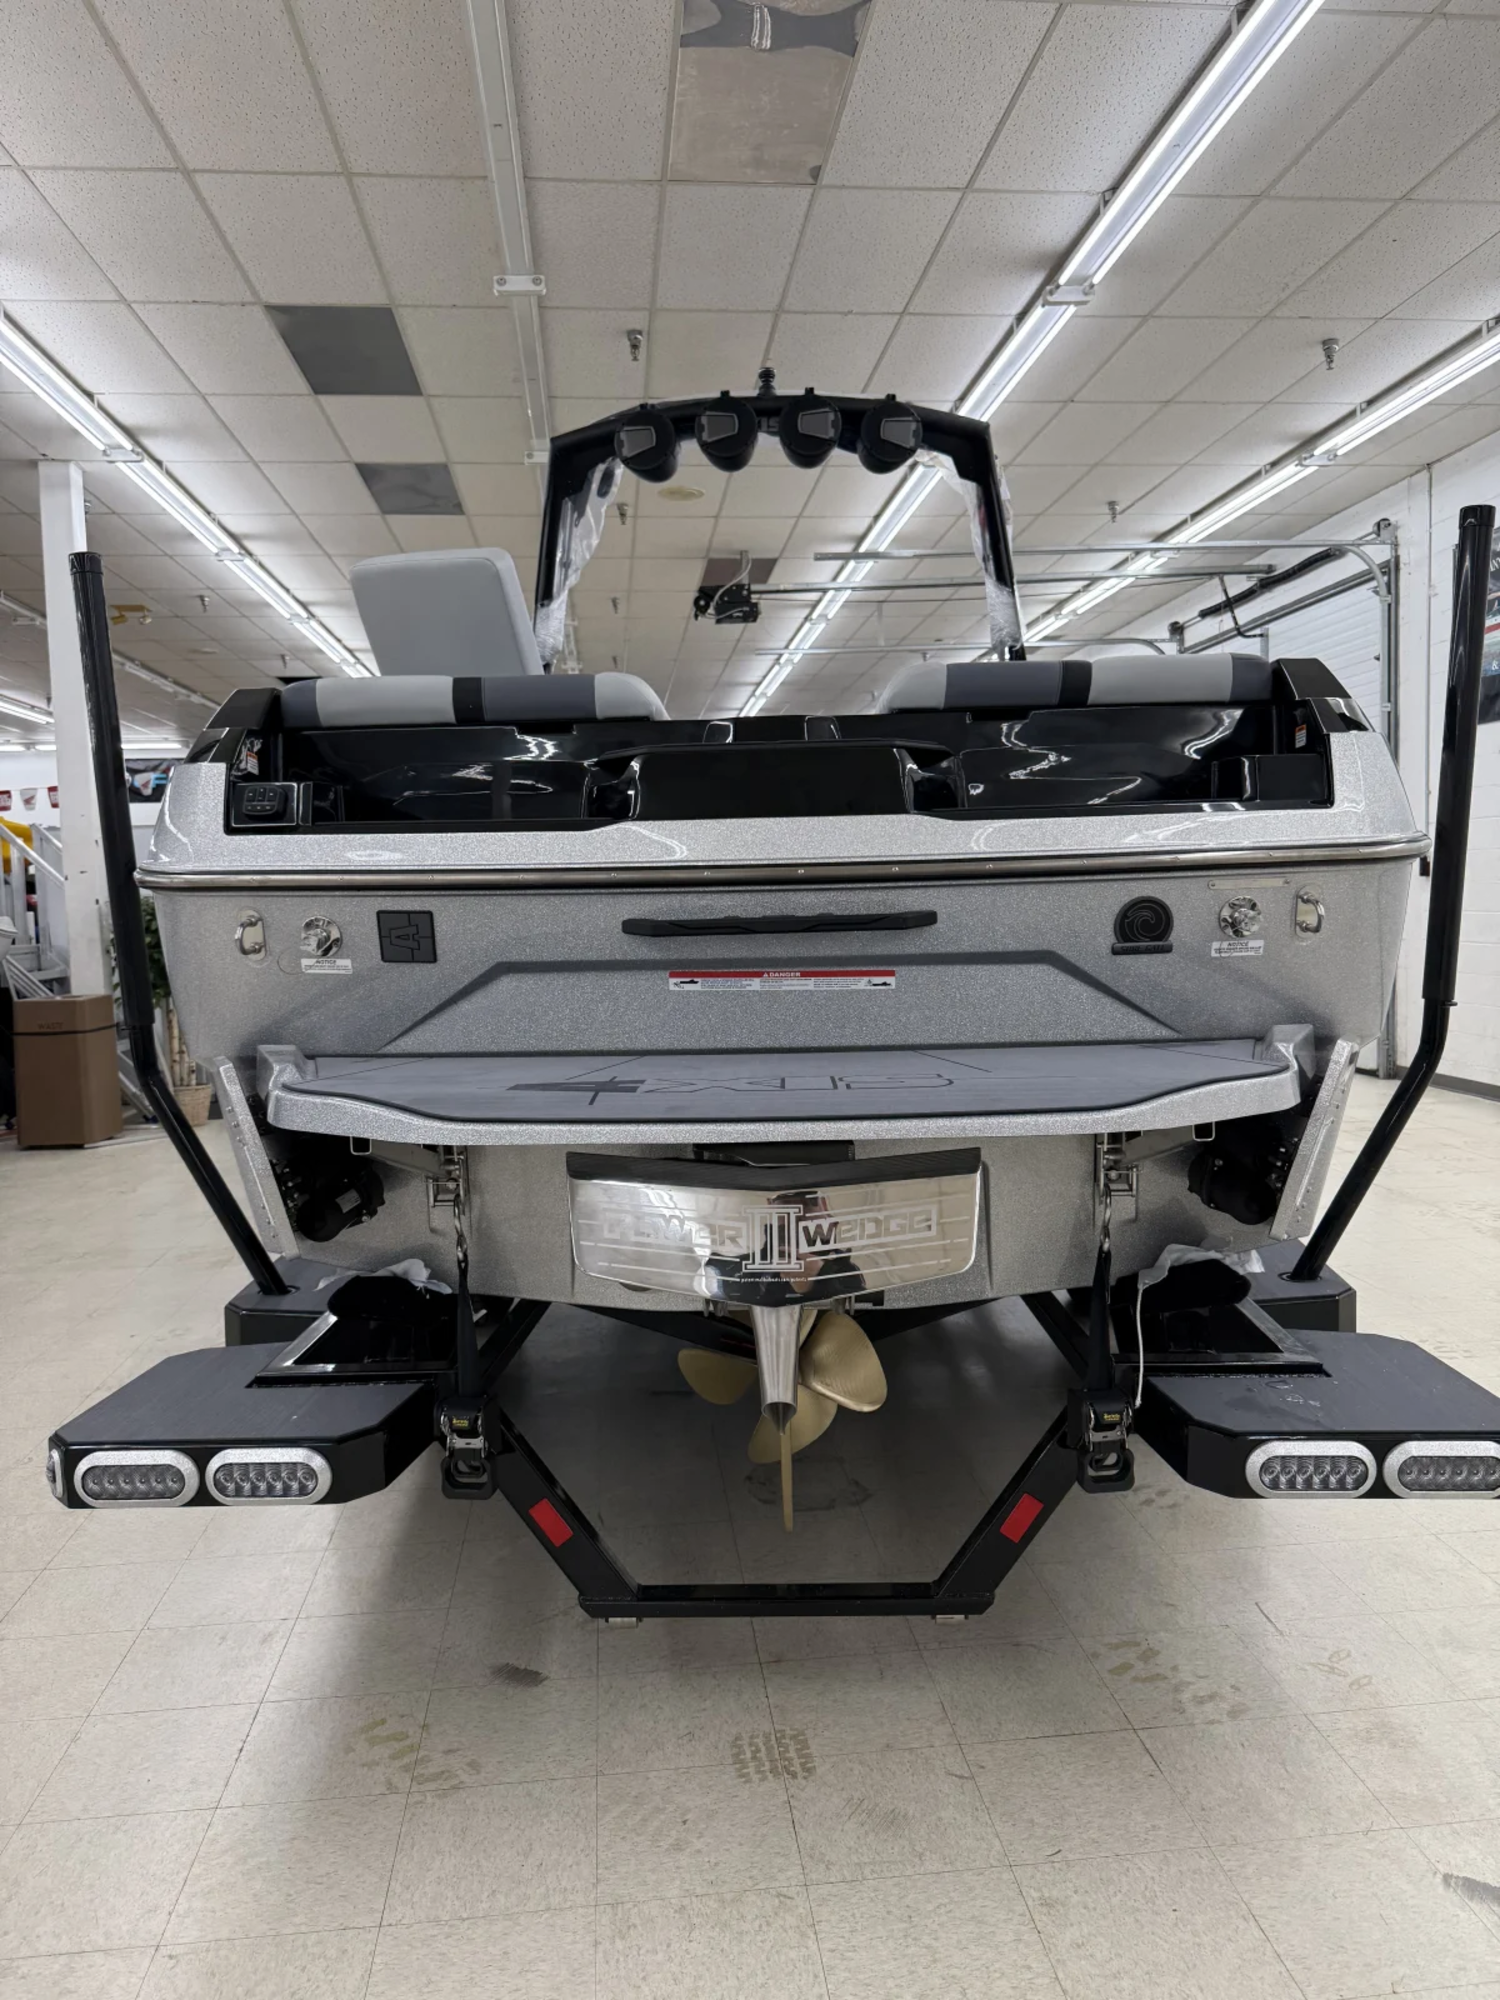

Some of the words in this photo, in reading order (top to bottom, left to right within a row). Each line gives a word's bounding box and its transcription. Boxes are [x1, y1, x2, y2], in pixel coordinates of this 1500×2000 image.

[38, 1022, 63, 1030] WASTE
[606, 1210, 746, 1254] POWER
[802, 1208, 934, 1249] WEDGE
